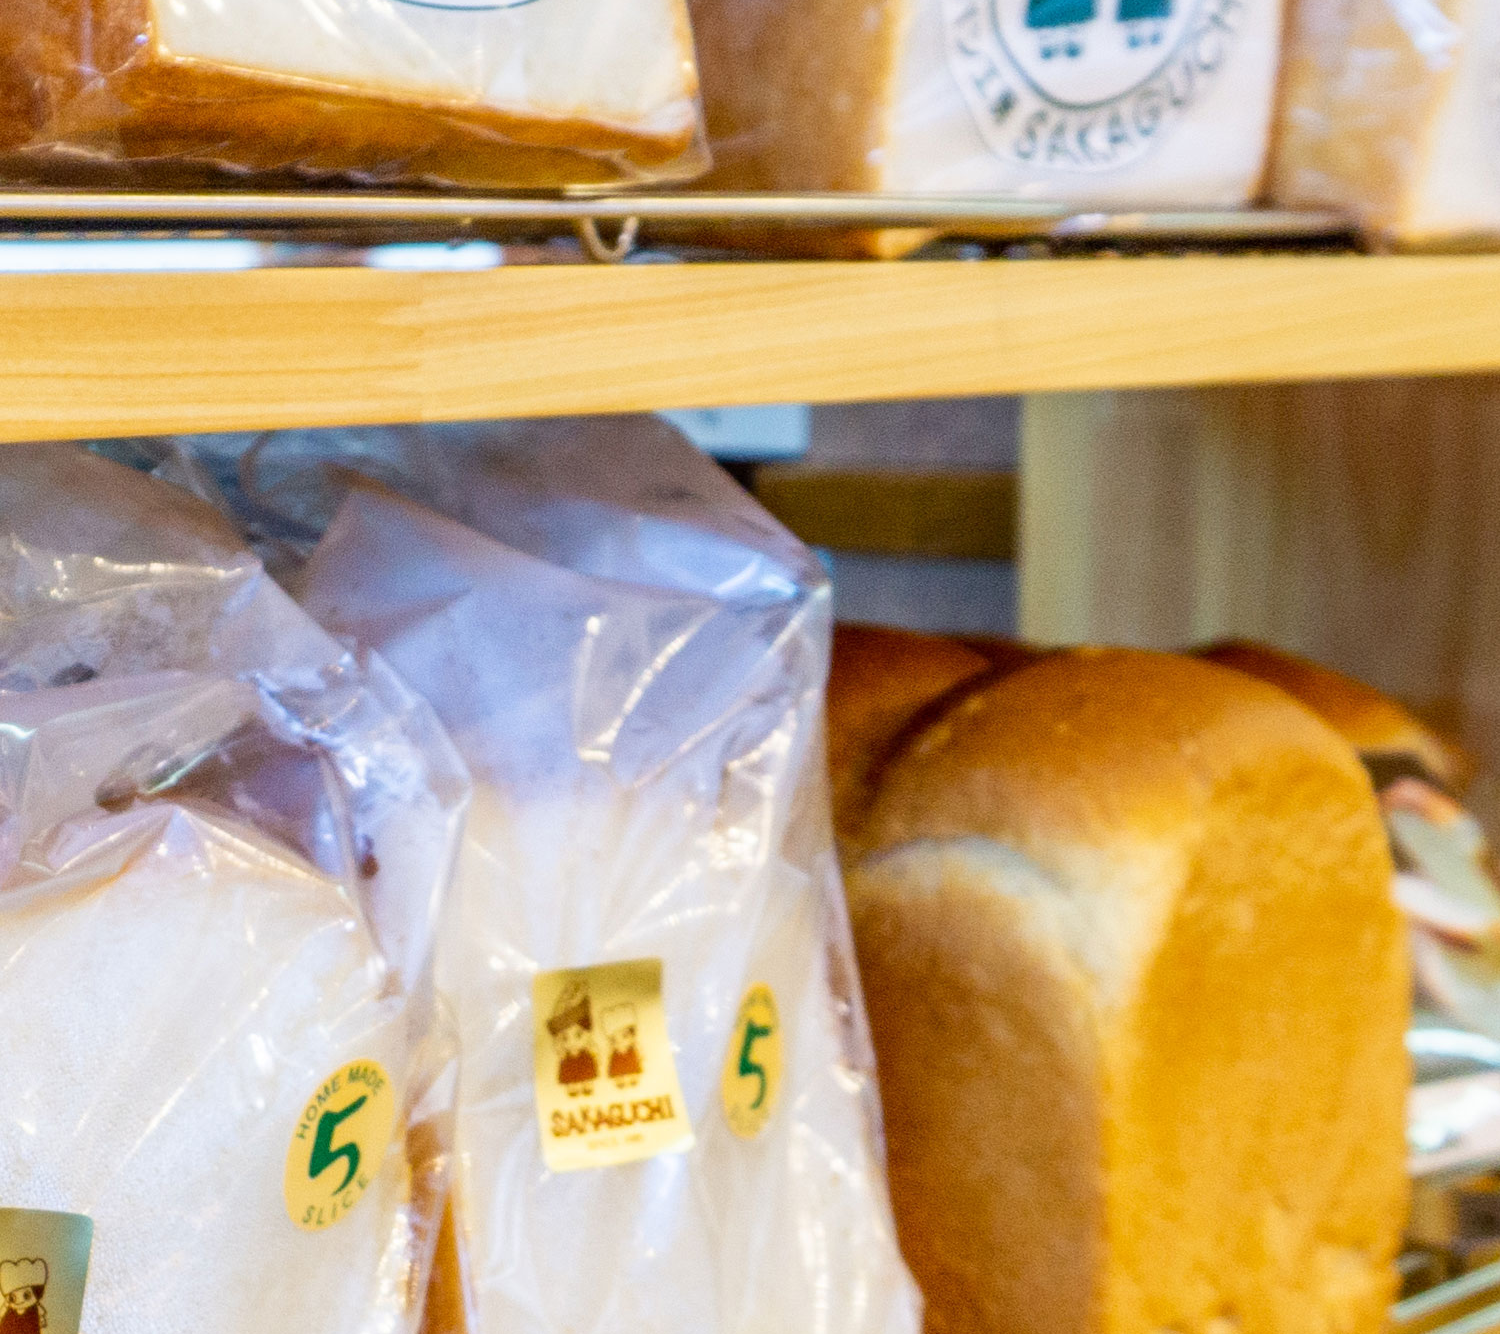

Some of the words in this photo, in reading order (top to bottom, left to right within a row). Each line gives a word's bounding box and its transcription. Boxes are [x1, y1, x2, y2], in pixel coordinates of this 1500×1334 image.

[738, 1017, 773, 1110] 5
[296, 1074, 341, 1140] HOME
[550, 1093, 675, 1138] SAKAGUCHI
[308, 1094, 369, 1197] 5
[302, 1172, 369, 1226] SLICE
